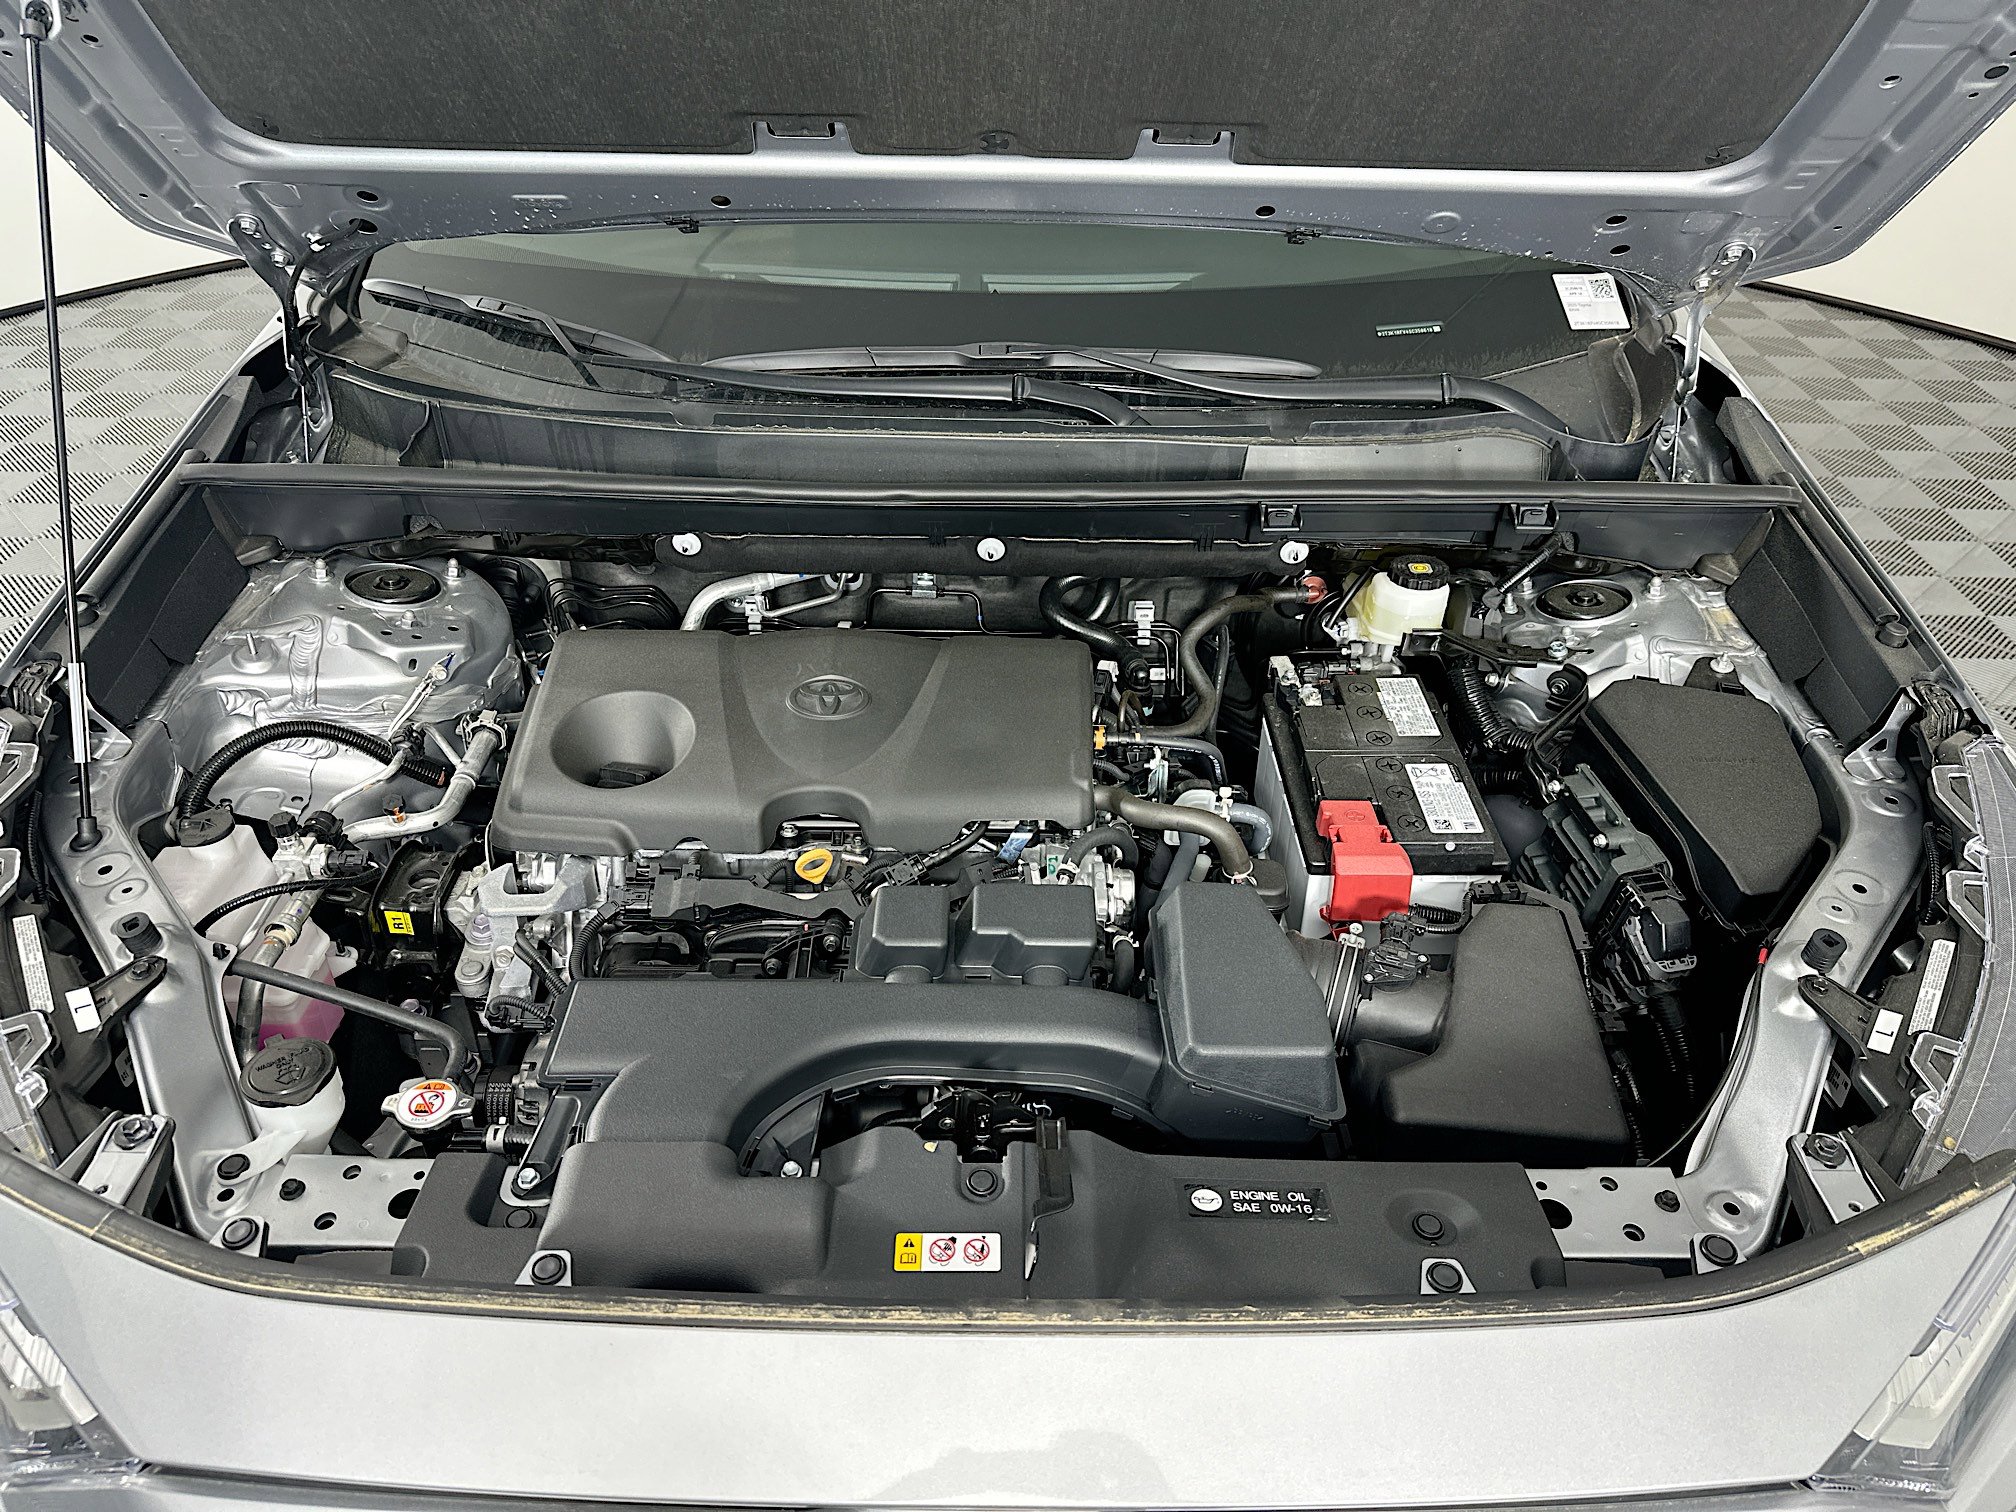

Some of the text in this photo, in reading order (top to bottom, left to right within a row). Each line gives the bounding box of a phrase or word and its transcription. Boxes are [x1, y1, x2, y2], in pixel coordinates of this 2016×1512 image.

[391, 917, 404, 929] R1
[1230, 1190, 1311, 1202] ENGINE OIL
[1233, 1202, 1313, 1214] SAE 0W-16
